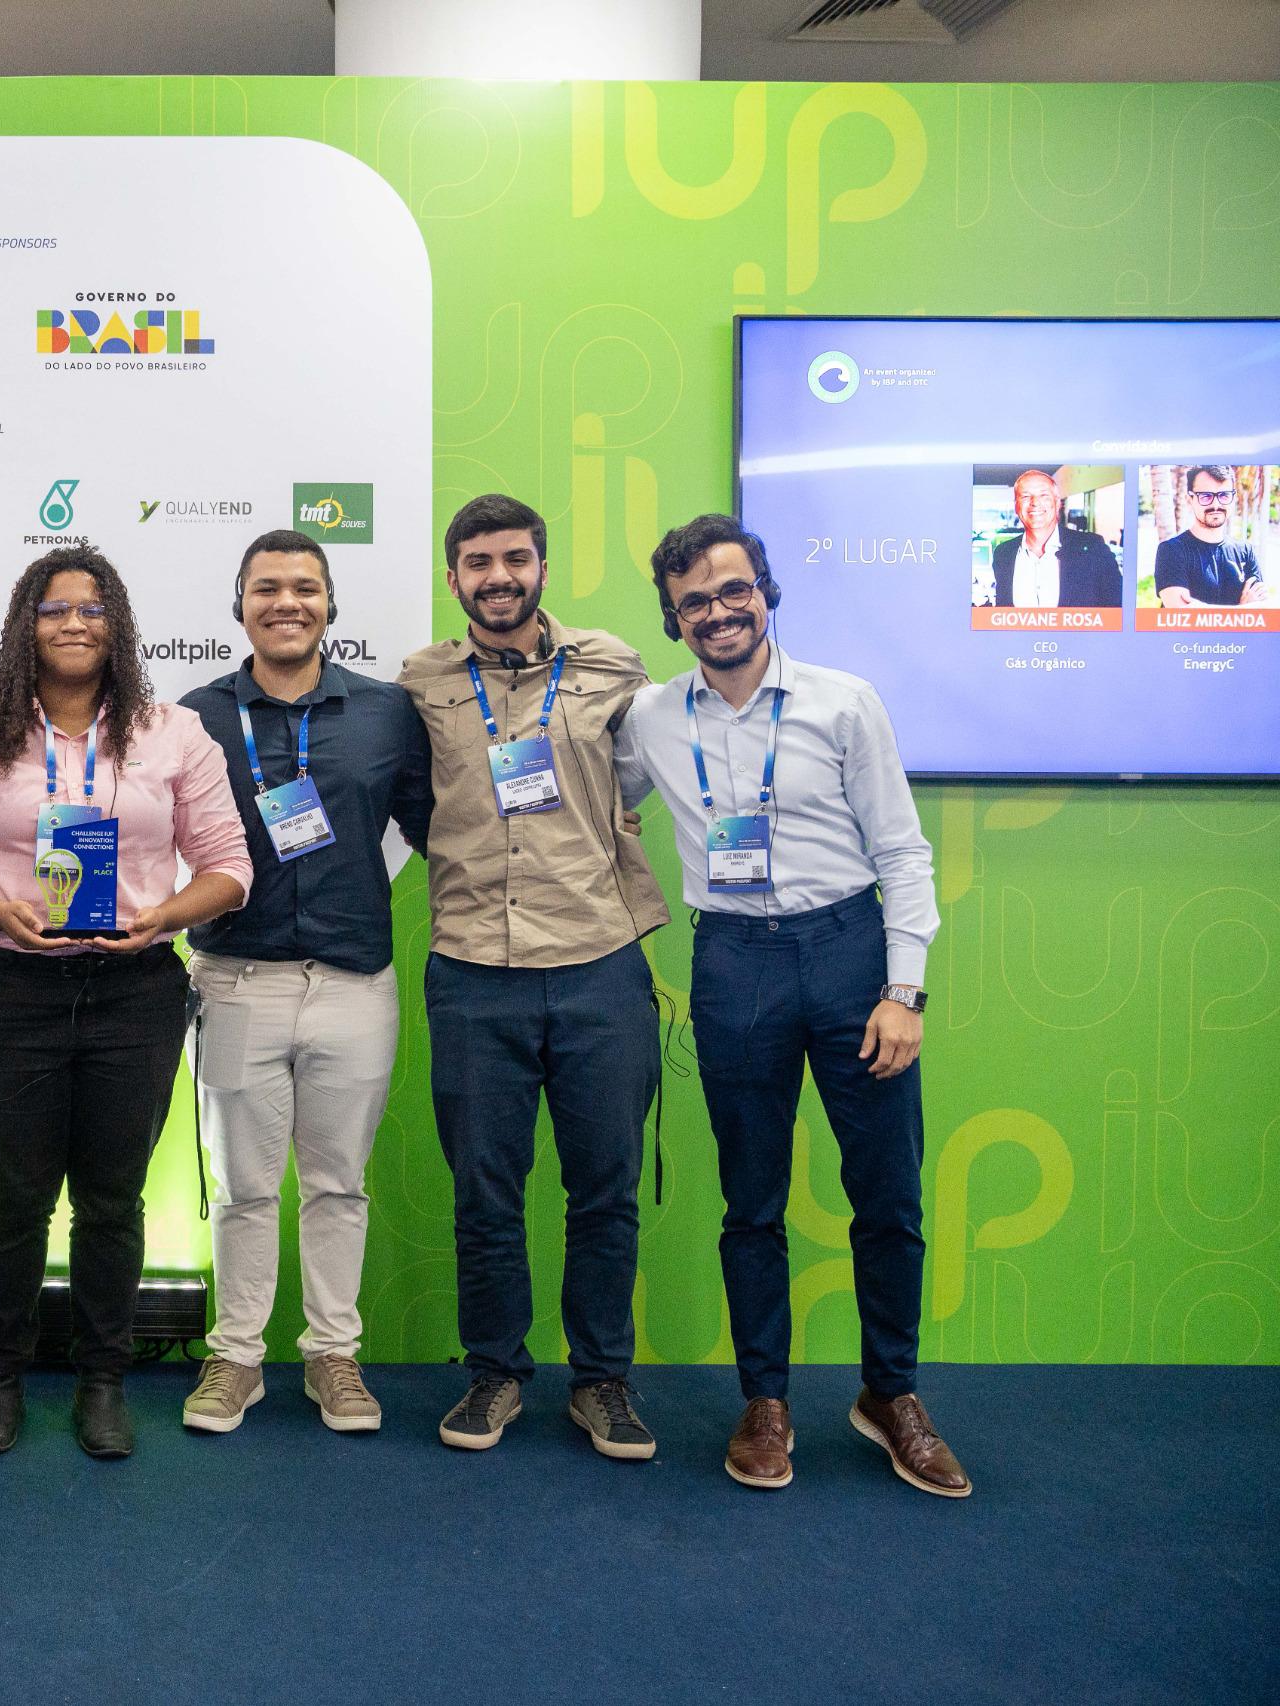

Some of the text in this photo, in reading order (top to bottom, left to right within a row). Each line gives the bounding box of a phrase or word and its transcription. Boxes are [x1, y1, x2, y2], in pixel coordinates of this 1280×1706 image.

[75, 292, 176, 302] GOVERNO DO
[36, 309, 215, 354] BRASIL
[45, 362, 207, 371] DO LADO DO POVO BRASILEIRO
[864, 368, 936, 378] An event organized
[871, 379, 881, 387] by
[1091, 440, 1172, 453] Convidados
[165, 501, 253, 516] QUALYEND
[300, 503, 332, 522] tmt
[340, 520, 367, 528] SOLVES
[24, 535, 89, 545] PETRONAS
[844, 537, 938, 564] LUGAR
[991, 612, 1104, 627] GIOVANE ROSA
[1157, 613, 1266, 628] LUIZ MIRANDA
[142, 637, 232, 664] voltpile
[321, 639, 377, 661] WDL
[1033, 641, 1058, 653] CEO
[1172, 642, 1247, 655] Co-fundador
[1005, 656, 1086, 671] Gás Orgânico
[1183, 658, 1235, 672] EnergyC
